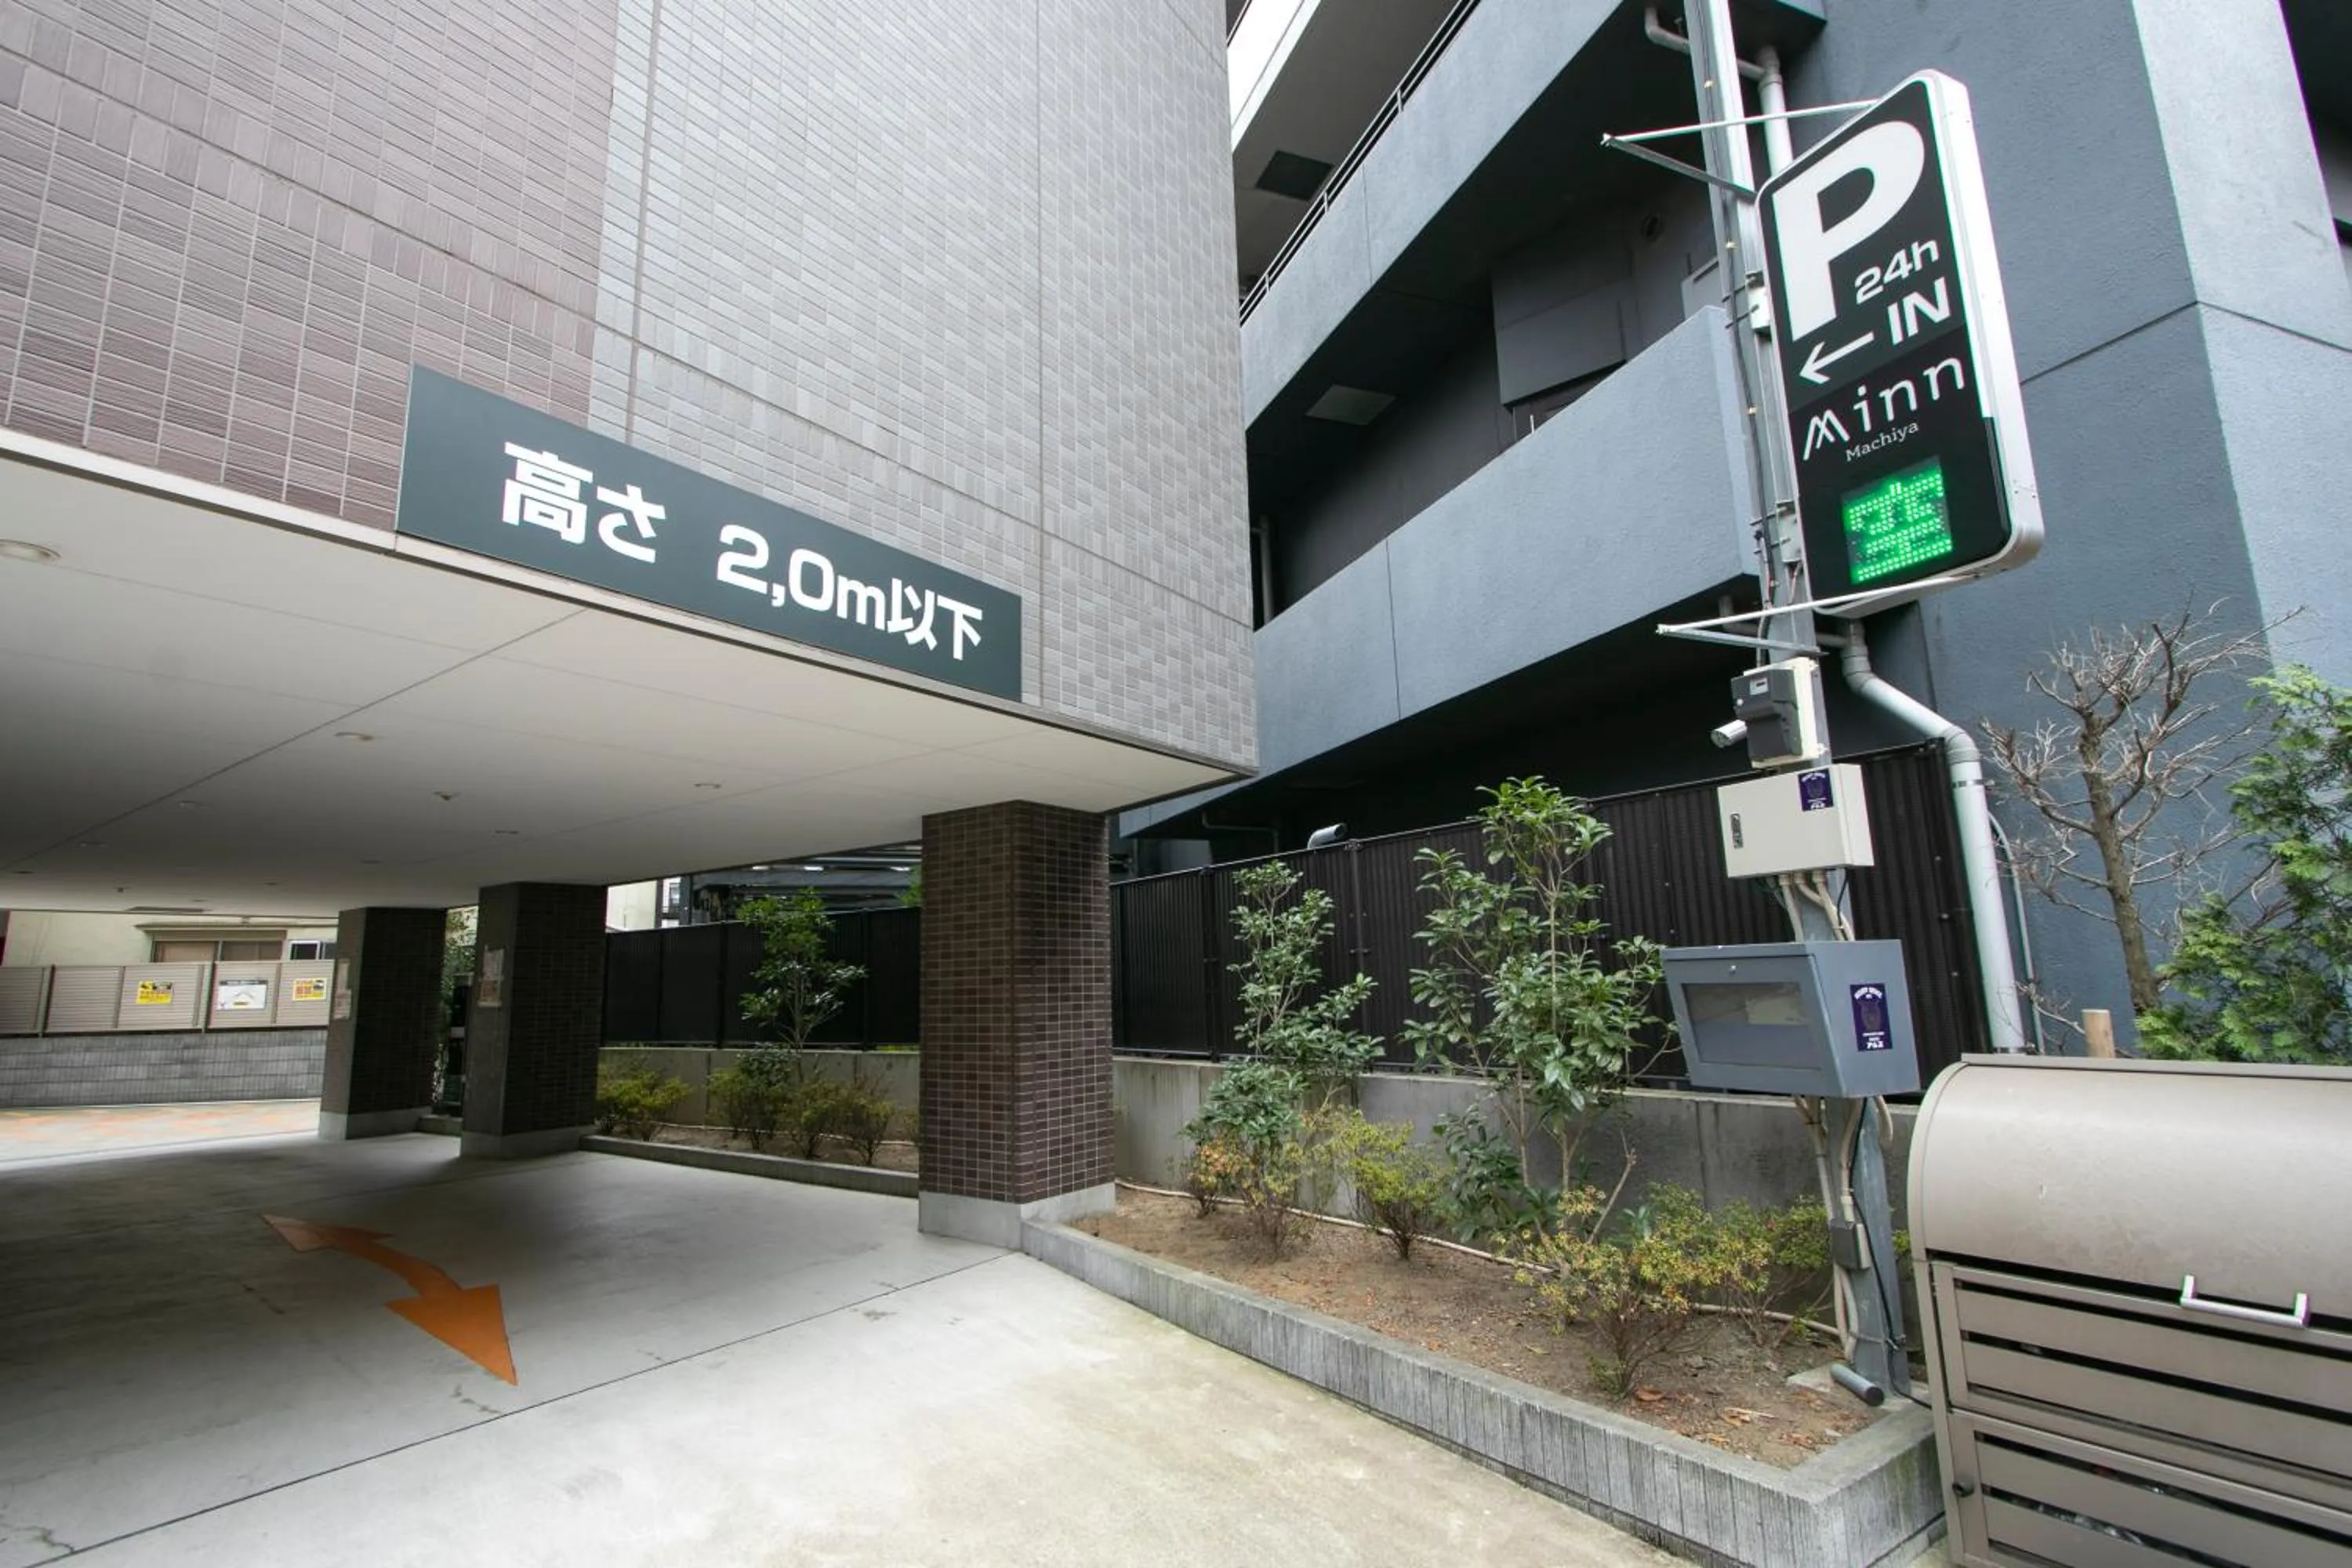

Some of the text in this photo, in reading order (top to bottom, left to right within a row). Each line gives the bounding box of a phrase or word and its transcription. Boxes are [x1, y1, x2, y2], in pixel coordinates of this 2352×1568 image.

[1772, 120, 1926, 342] P
[1854, 238, 1940, 305] 24h
[1886, 276, 1951, 346] IN
[1802, 356, 1965, 461] Minn
[1845, 419, 1919, 463] Machiya
[502, 441, 666, 564] 高さ
[1848, 473, 1953, 583] 空
